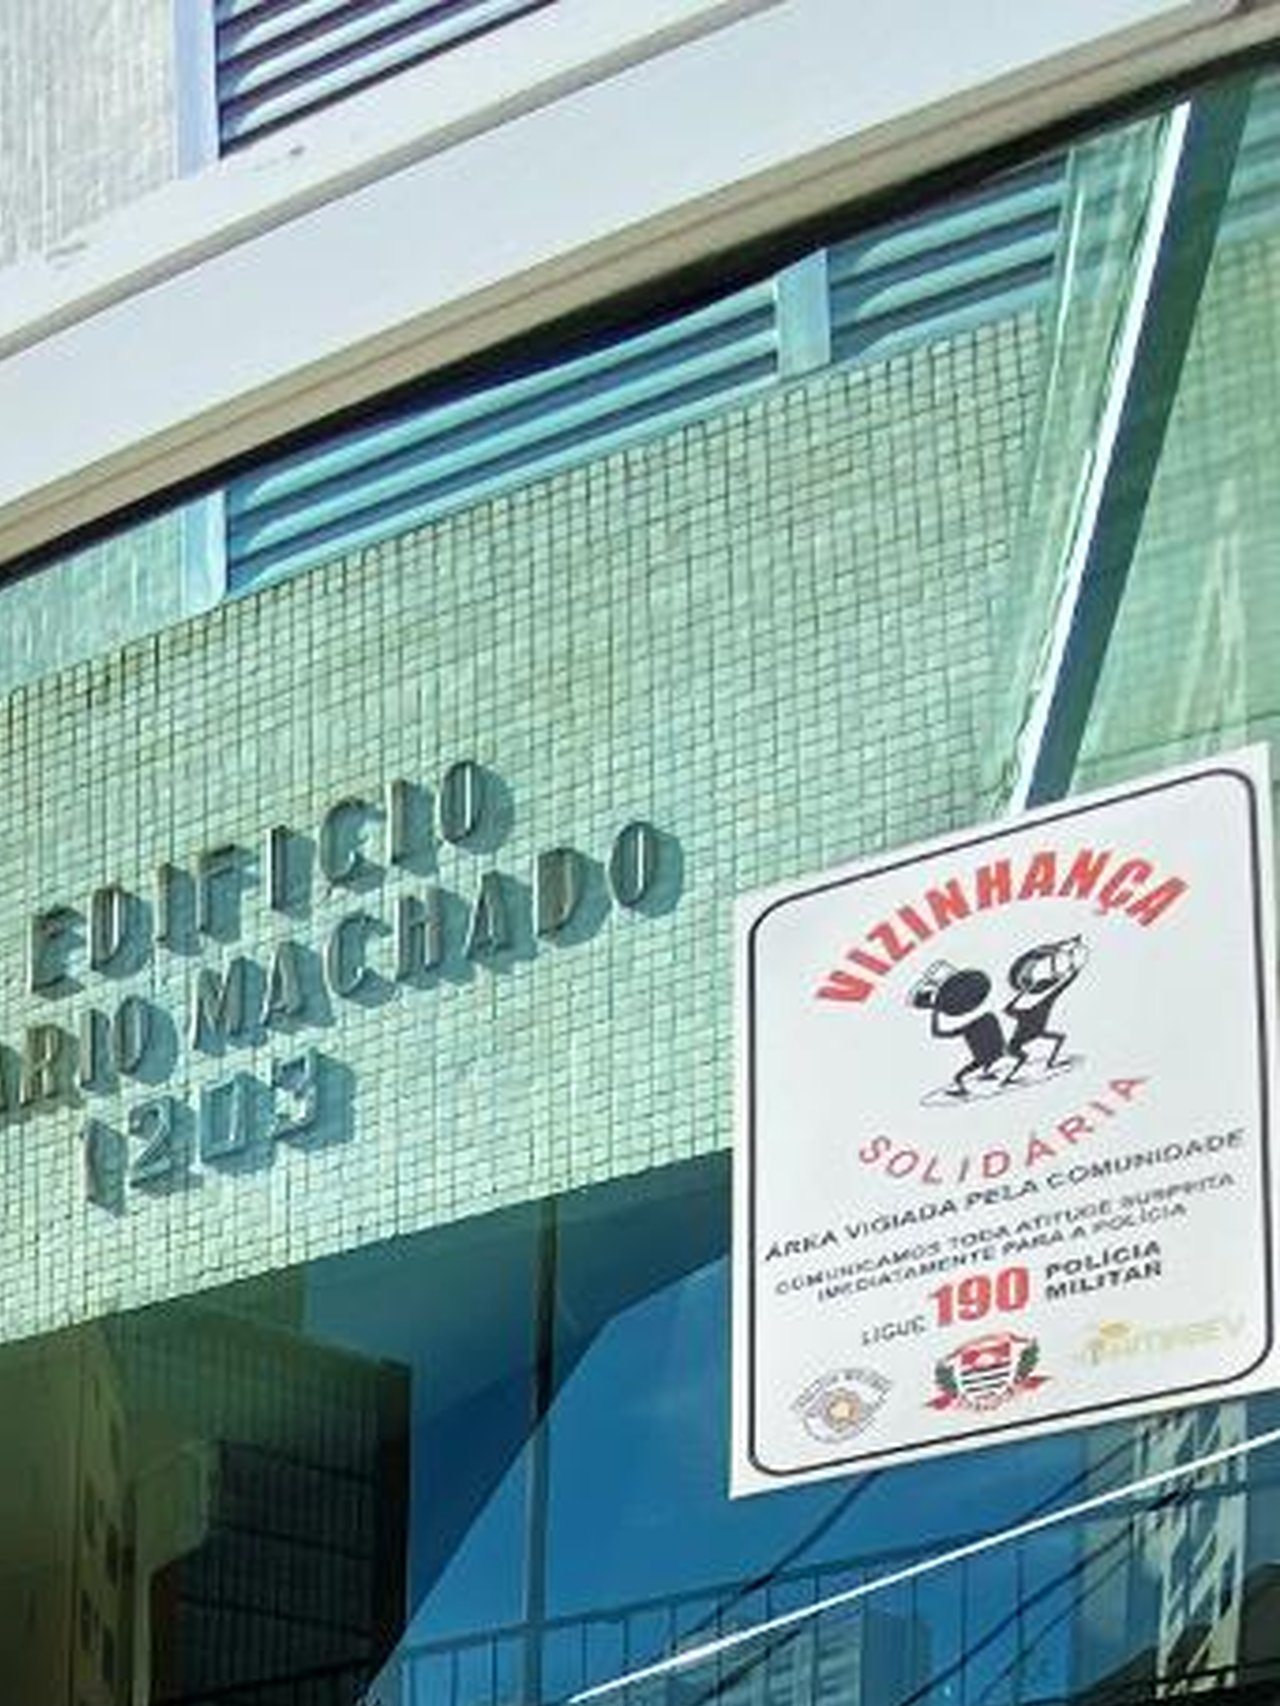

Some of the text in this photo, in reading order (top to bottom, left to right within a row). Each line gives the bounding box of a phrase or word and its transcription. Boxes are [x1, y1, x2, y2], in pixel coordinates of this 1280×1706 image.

[28, 758, 500, 997] EDIFICIO
[190, 820, 670, 1055] MACHADO
[814, 846, 1190, 1006] VIZINHANÇA
[80, 1045, 336, 1210] 1203
[845, 1199, 959, 1240] VIGIADA
[964, 1178, 1039, 1210] PELA
[1046, 1128, 1246, 1191] COMUNIDADE
[861, 1266, 1031, 1346] LIGUE 190
[1045, 1259, 1162, 1301] MILITAR
